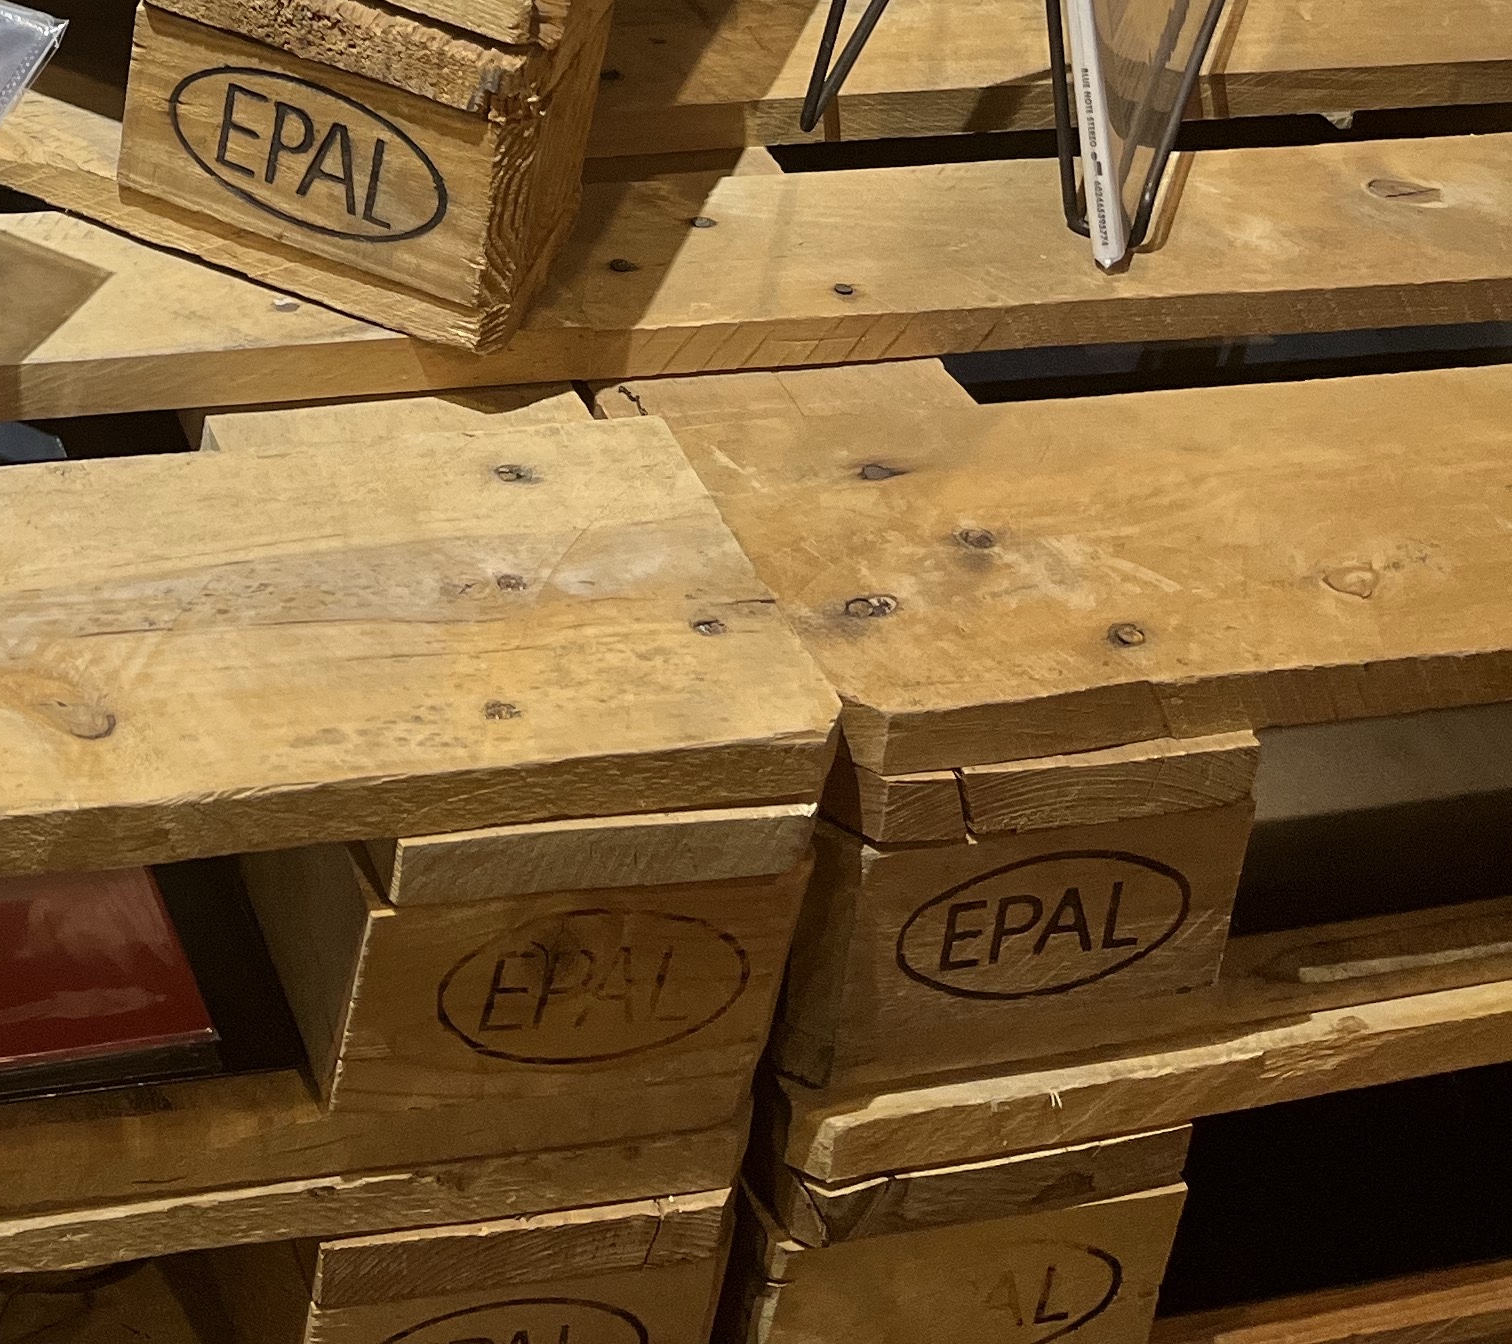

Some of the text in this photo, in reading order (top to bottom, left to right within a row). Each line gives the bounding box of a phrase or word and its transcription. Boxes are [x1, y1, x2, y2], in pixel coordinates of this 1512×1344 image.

[1081, 68, 1091, 88] BLUE
[215, 83, 391, 229] EPAL
[938, 880, 1140, 972] EPAL
